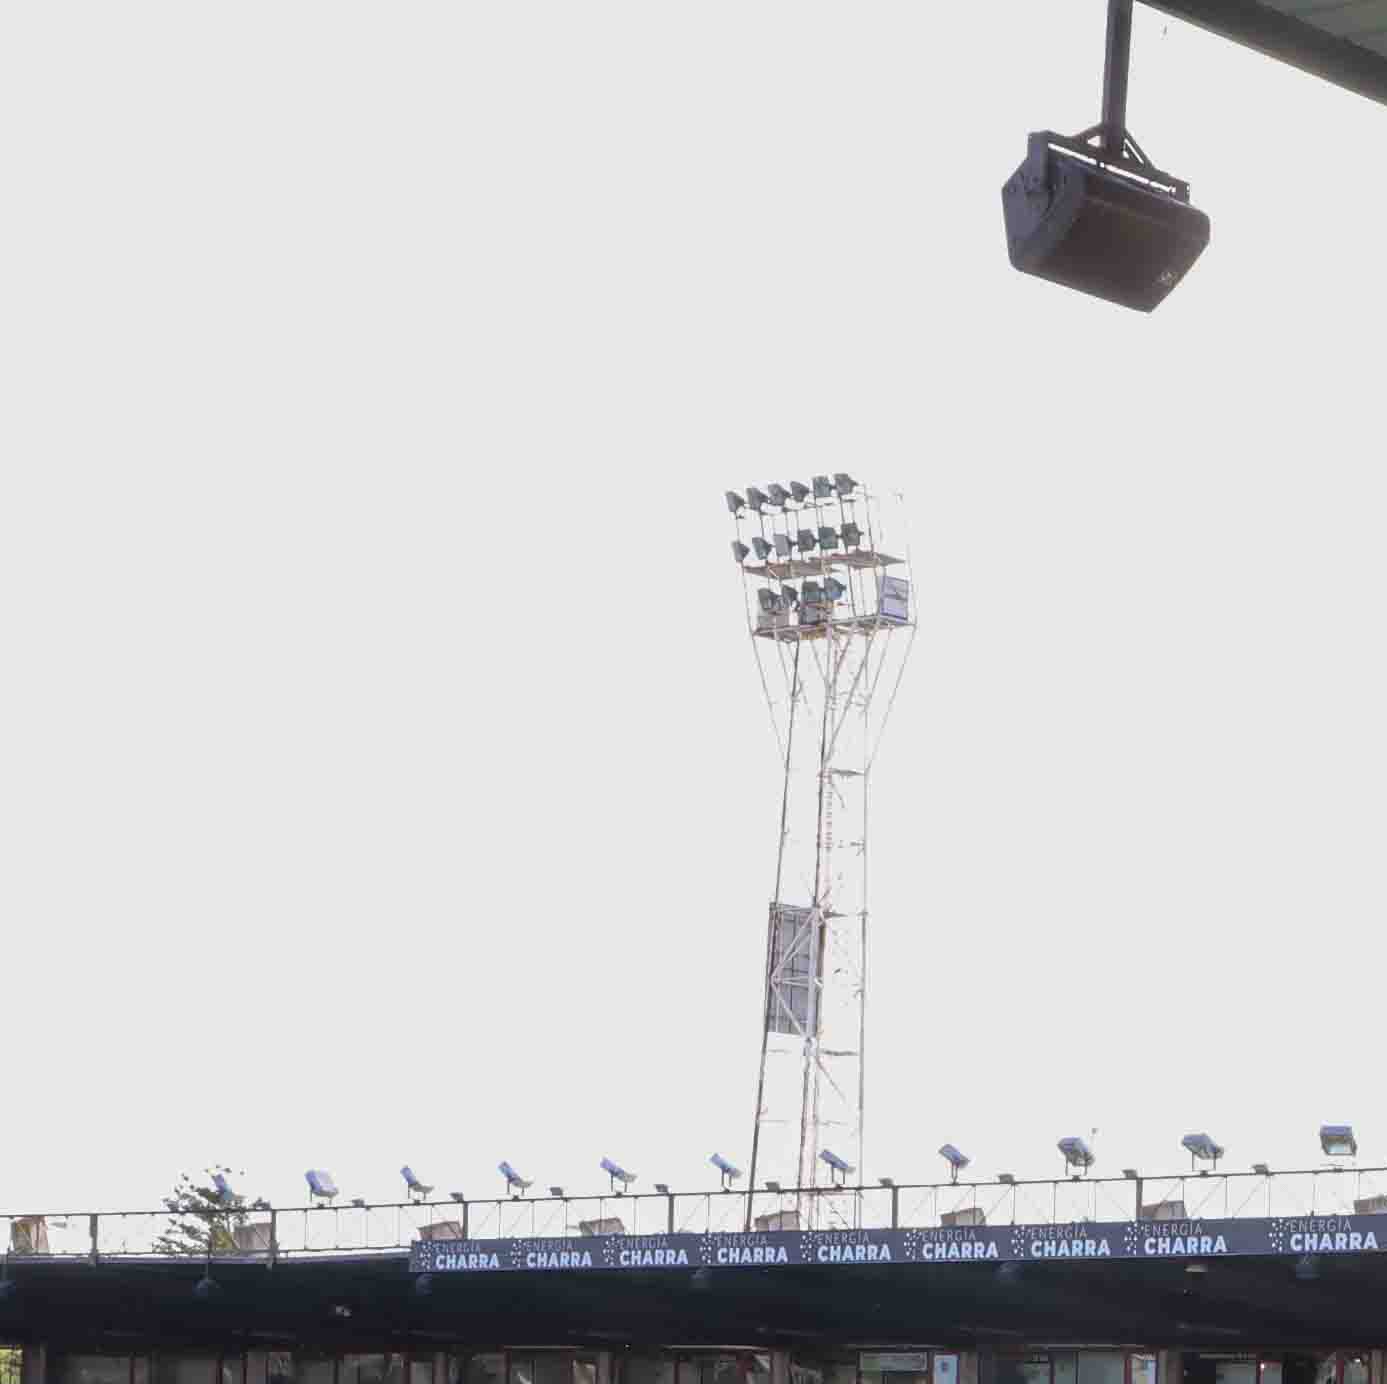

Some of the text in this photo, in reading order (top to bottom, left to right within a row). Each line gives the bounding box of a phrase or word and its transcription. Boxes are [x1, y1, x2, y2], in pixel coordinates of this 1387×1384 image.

[922, 1241, 999, 1259] CHARRA
[1031, 1239, 1111, 1257] CHARRA
[1144, 1236, 1227, 1254] CHARRA
[1290, 1231, 1378, 1251] CHARRA
[435, 1253, 500, 1270] CHARRA
[526, 1251, 592, 1267] CHARRA
[619, 1249, 689, 1266] CHARRA
[717, 1246, 788, 1263] CHARRA
[818, 1244, 891, 1262] CHARRA
